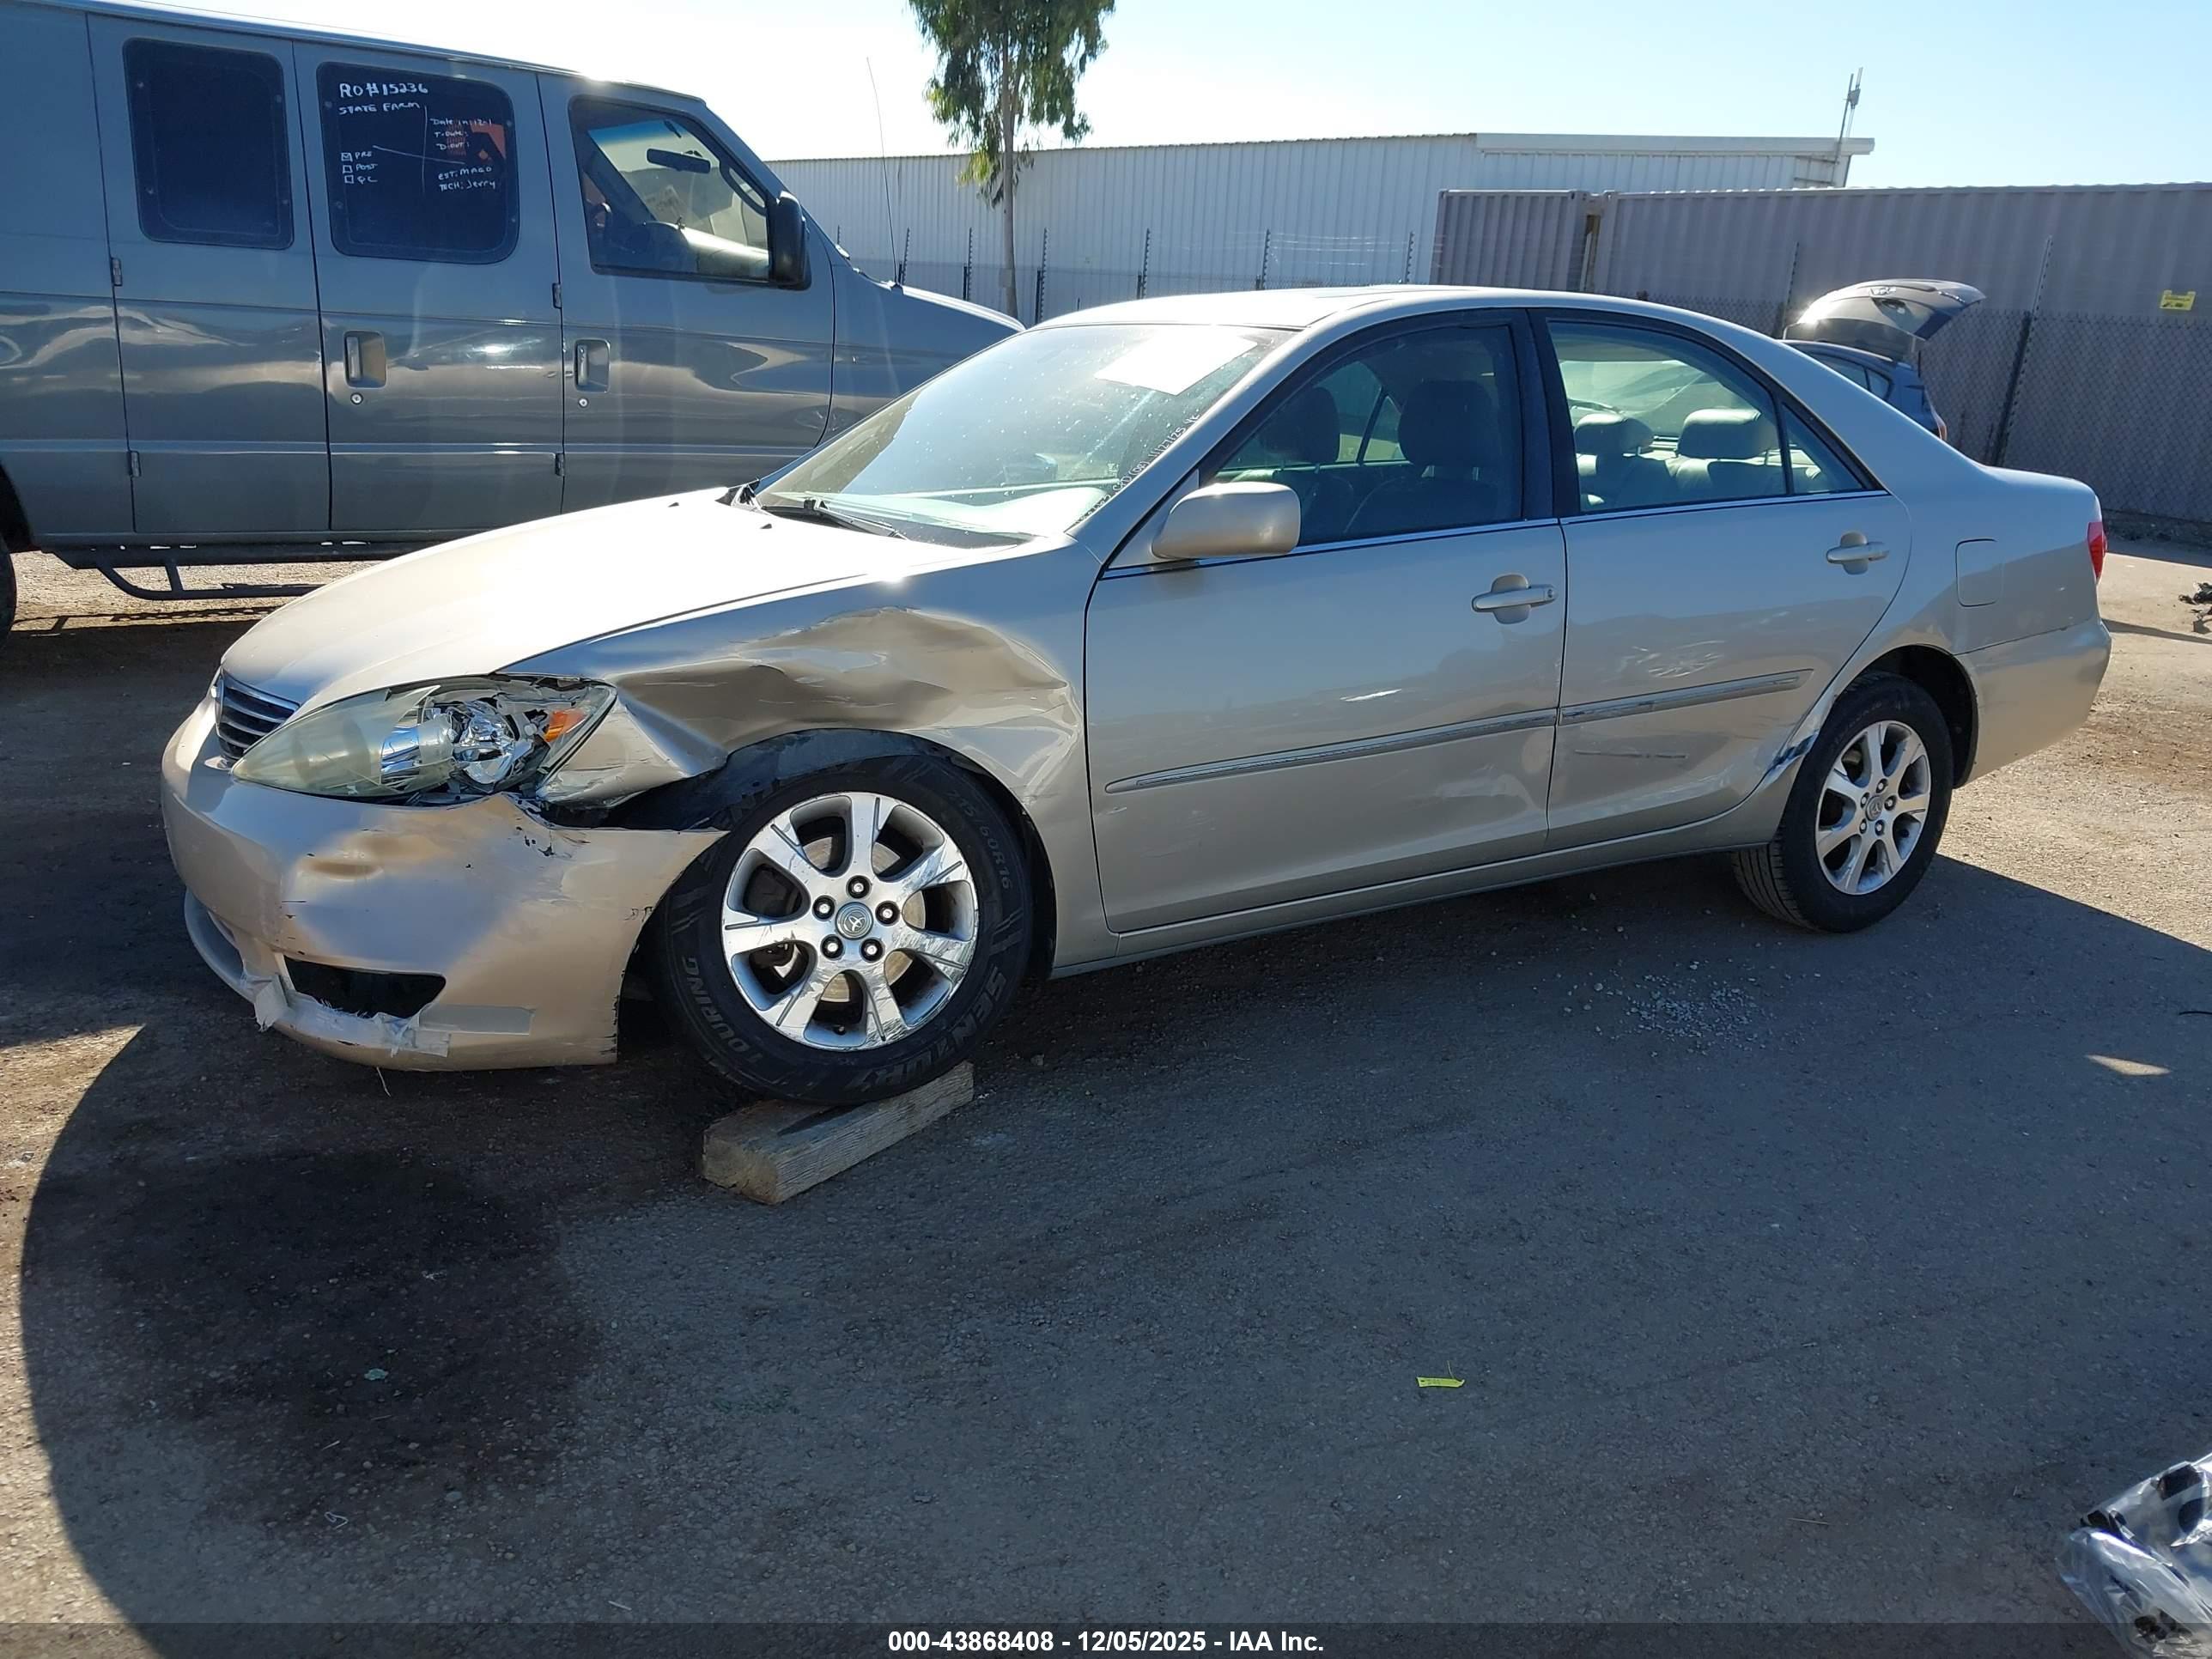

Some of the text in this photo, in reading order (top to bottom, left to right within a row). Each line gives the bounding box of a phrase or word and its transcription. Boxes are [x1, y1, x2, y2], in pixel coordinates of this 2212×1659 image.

[338, 101, 421, 116] STATE FARM
[355, 151, 372, 160] PRE
[357, 175, 378, 185] QC
[466, 179, 495, 190] Jerry
